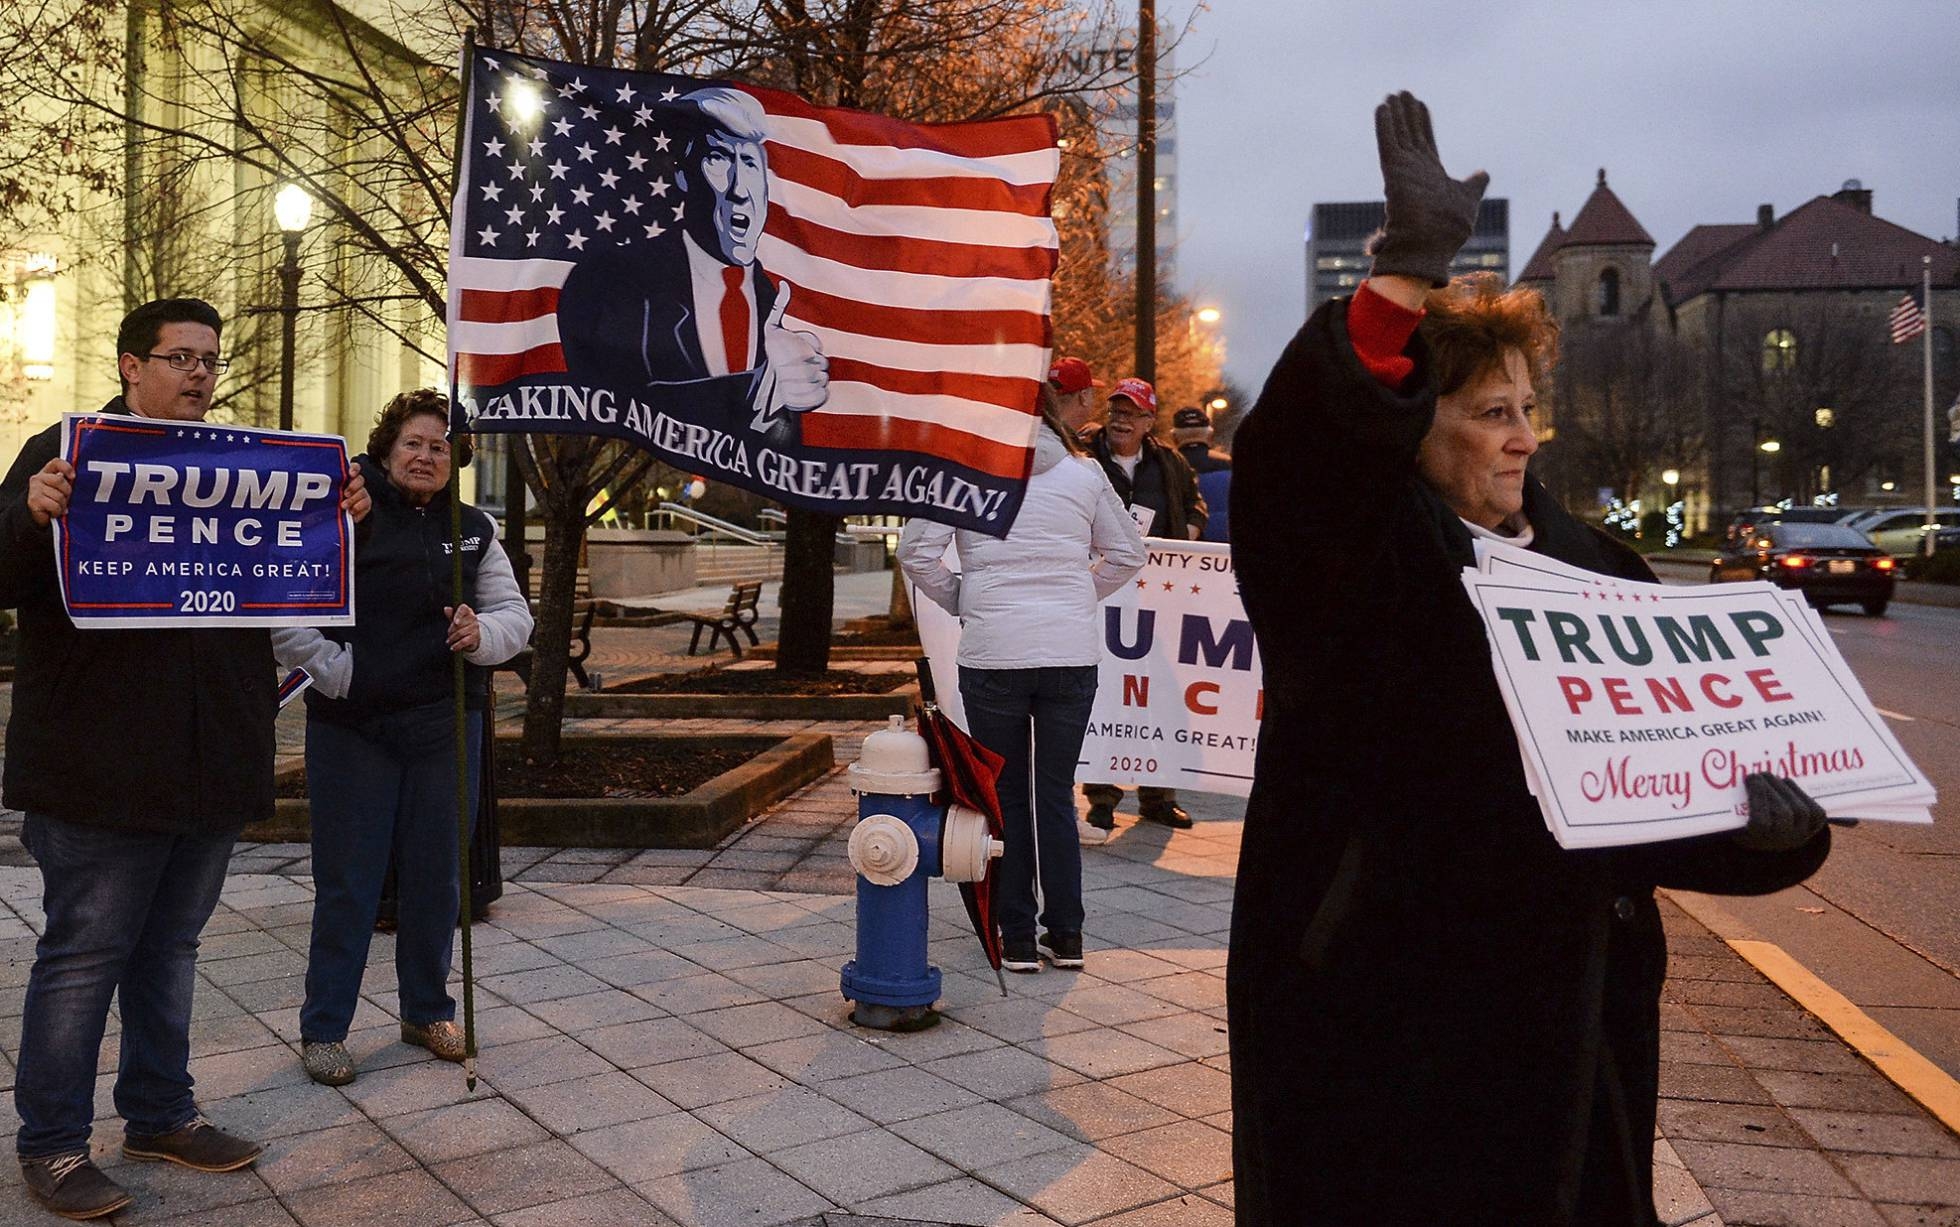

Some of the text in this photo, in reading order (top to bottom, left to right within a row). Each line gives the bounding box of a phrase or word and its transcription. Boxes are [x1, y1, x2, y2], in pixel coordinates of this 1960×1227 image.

[462, 385, 1008, 522] MAKING AMERICA GREAT AGAIN!
[87, 461, 332, 511] TRUMP
[105, 514, 303, 547] PENCE
[79, 561, 331, 578] KEEP AMERICA GREAT!
[1200, 556, 1235, 574] SU
[179, 590, 236, 612] 2020
[1496, 606, 1785, 667] TRUMP
[1556, 667, 1794, 715] PENCE
[1086, 722, 1256, 752] AMERICA GREAT!
[1566, 709, 1826, 744] MAKE AMERICA GREAT AGAIN!
[1110, 756, 1158, 773] 2020
[1580, 755, 1691, 809] Merry
